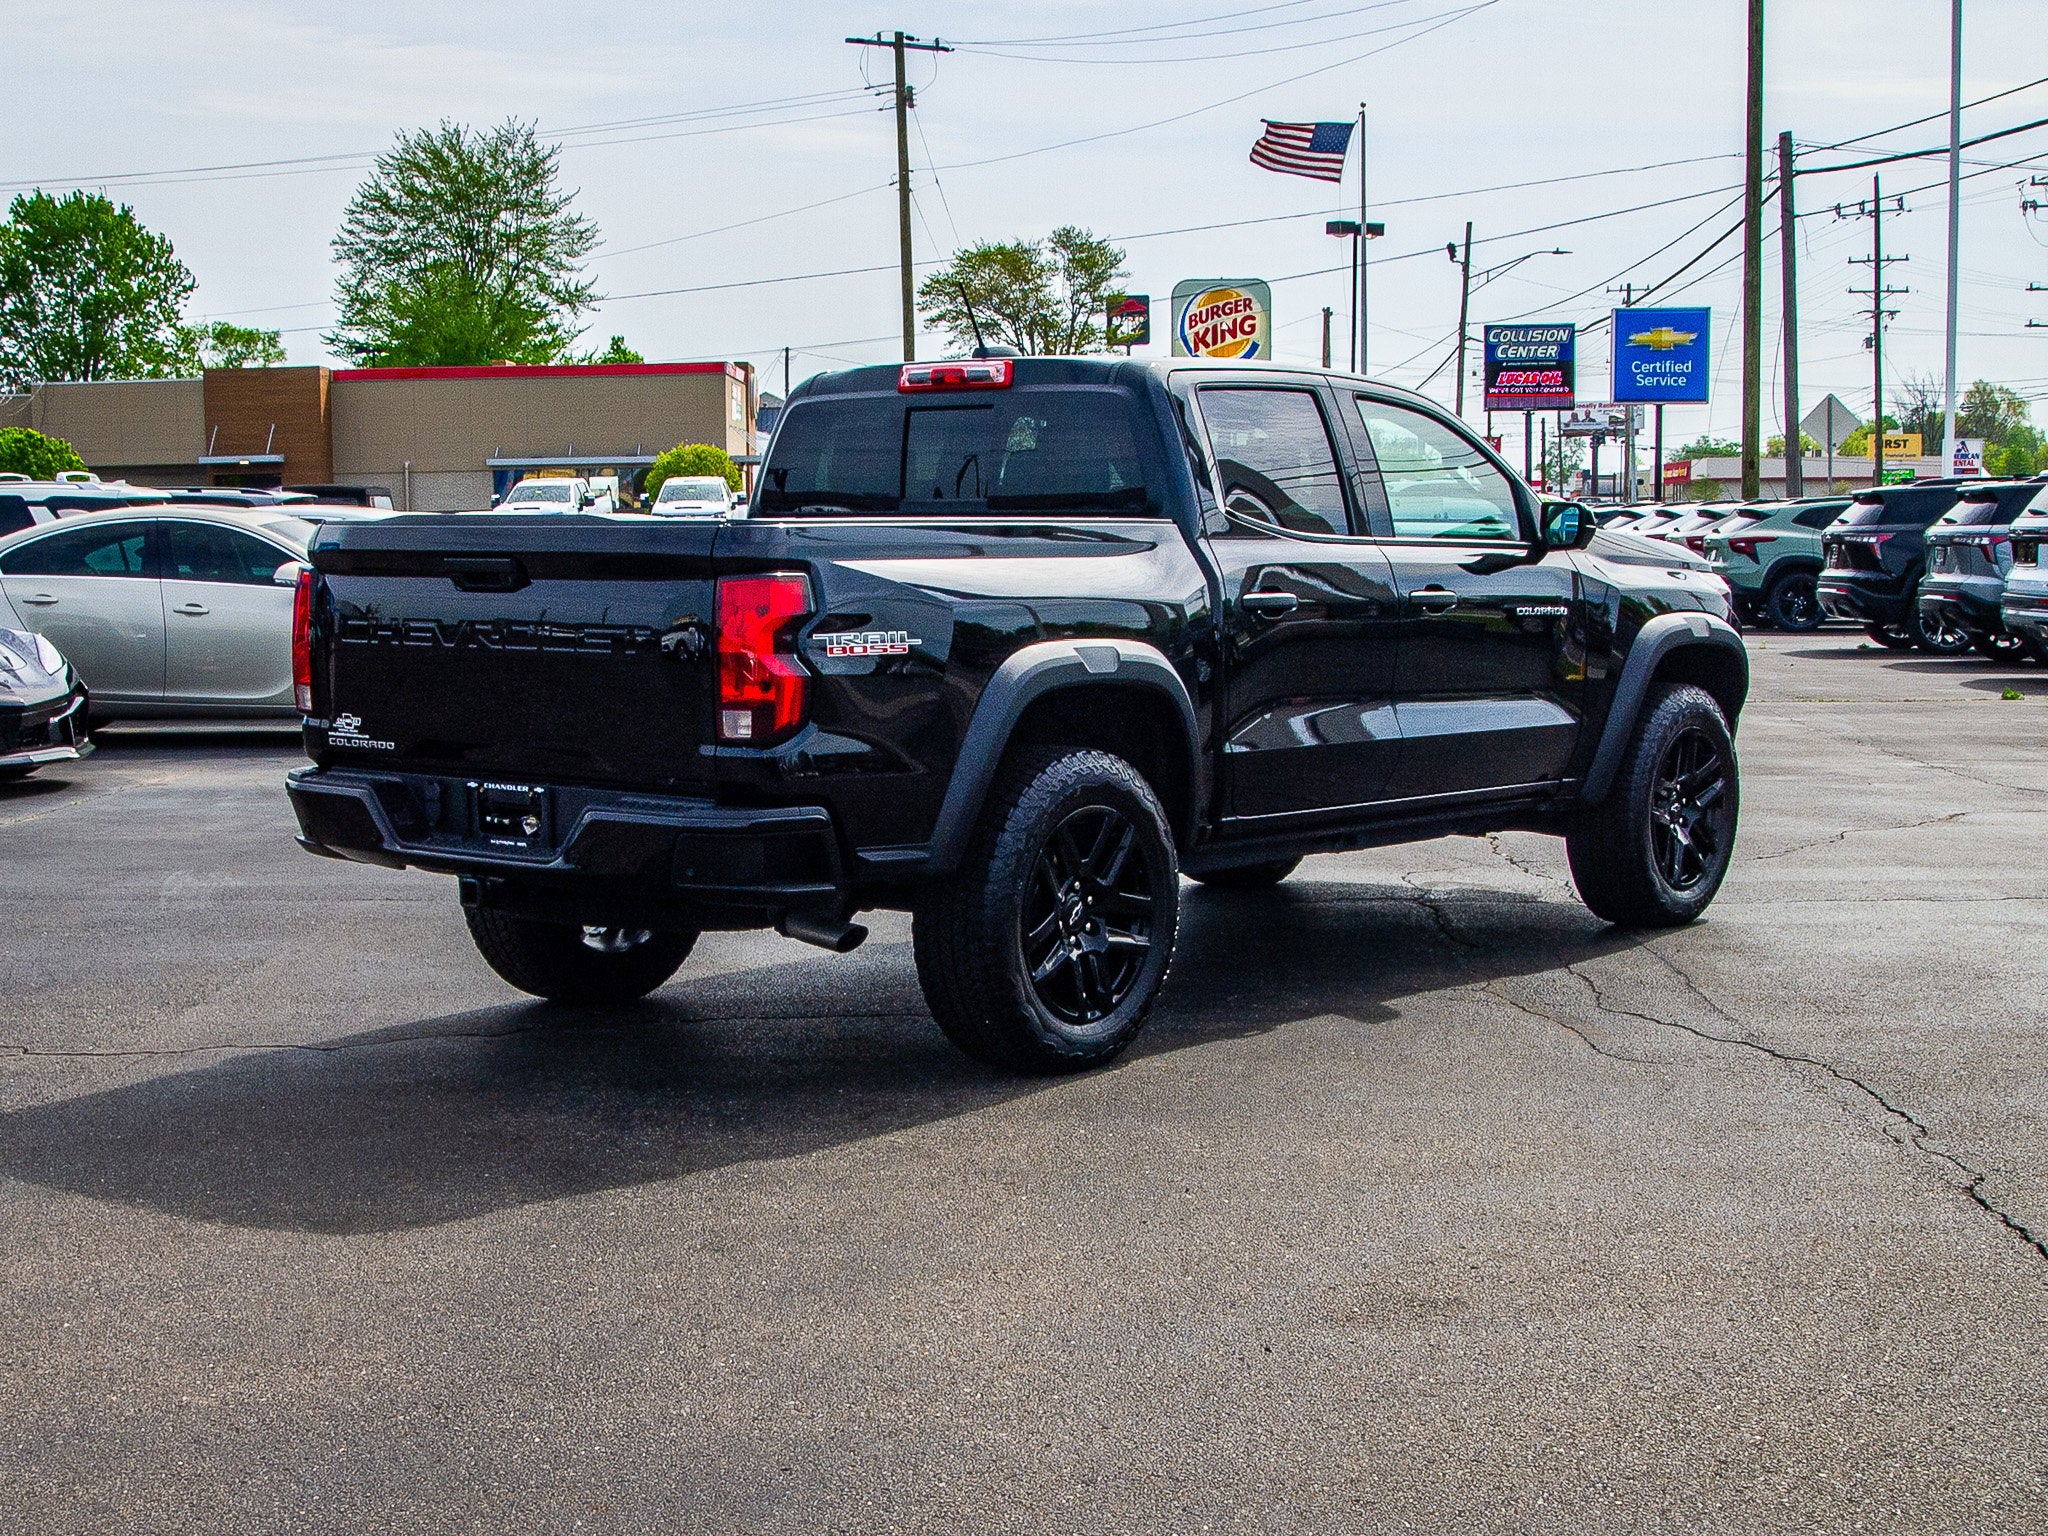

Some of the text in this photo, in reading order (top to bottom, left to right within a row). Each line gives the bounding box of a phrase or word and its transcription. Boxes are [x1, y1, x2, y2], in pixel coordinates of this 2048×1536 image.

[1188, 297, 1253, 330] BURGER
[1192, 314, 1257, 353] KING
[1488, 327, 1571, 343] COLLISION
[1496, 344, 1559, 359] CENTER
[1631, 360, 1692, 374] Certified
[1496, 371, 1563, 386] LUCAS OIL
[1636, 374, 1687, 386] Service
[1882, 438, 1909, 449] RST
[1516, 606, 1568, 616] COLORADO
[341, 618, 651, 654] CHEVROLET
[812, 630, 922, 646] TRAIL
[827, 644, 909, 657] BOSS
[328, 737, 395, 750] COLORADO
[483, 782, 529, 792] CHANDLER
